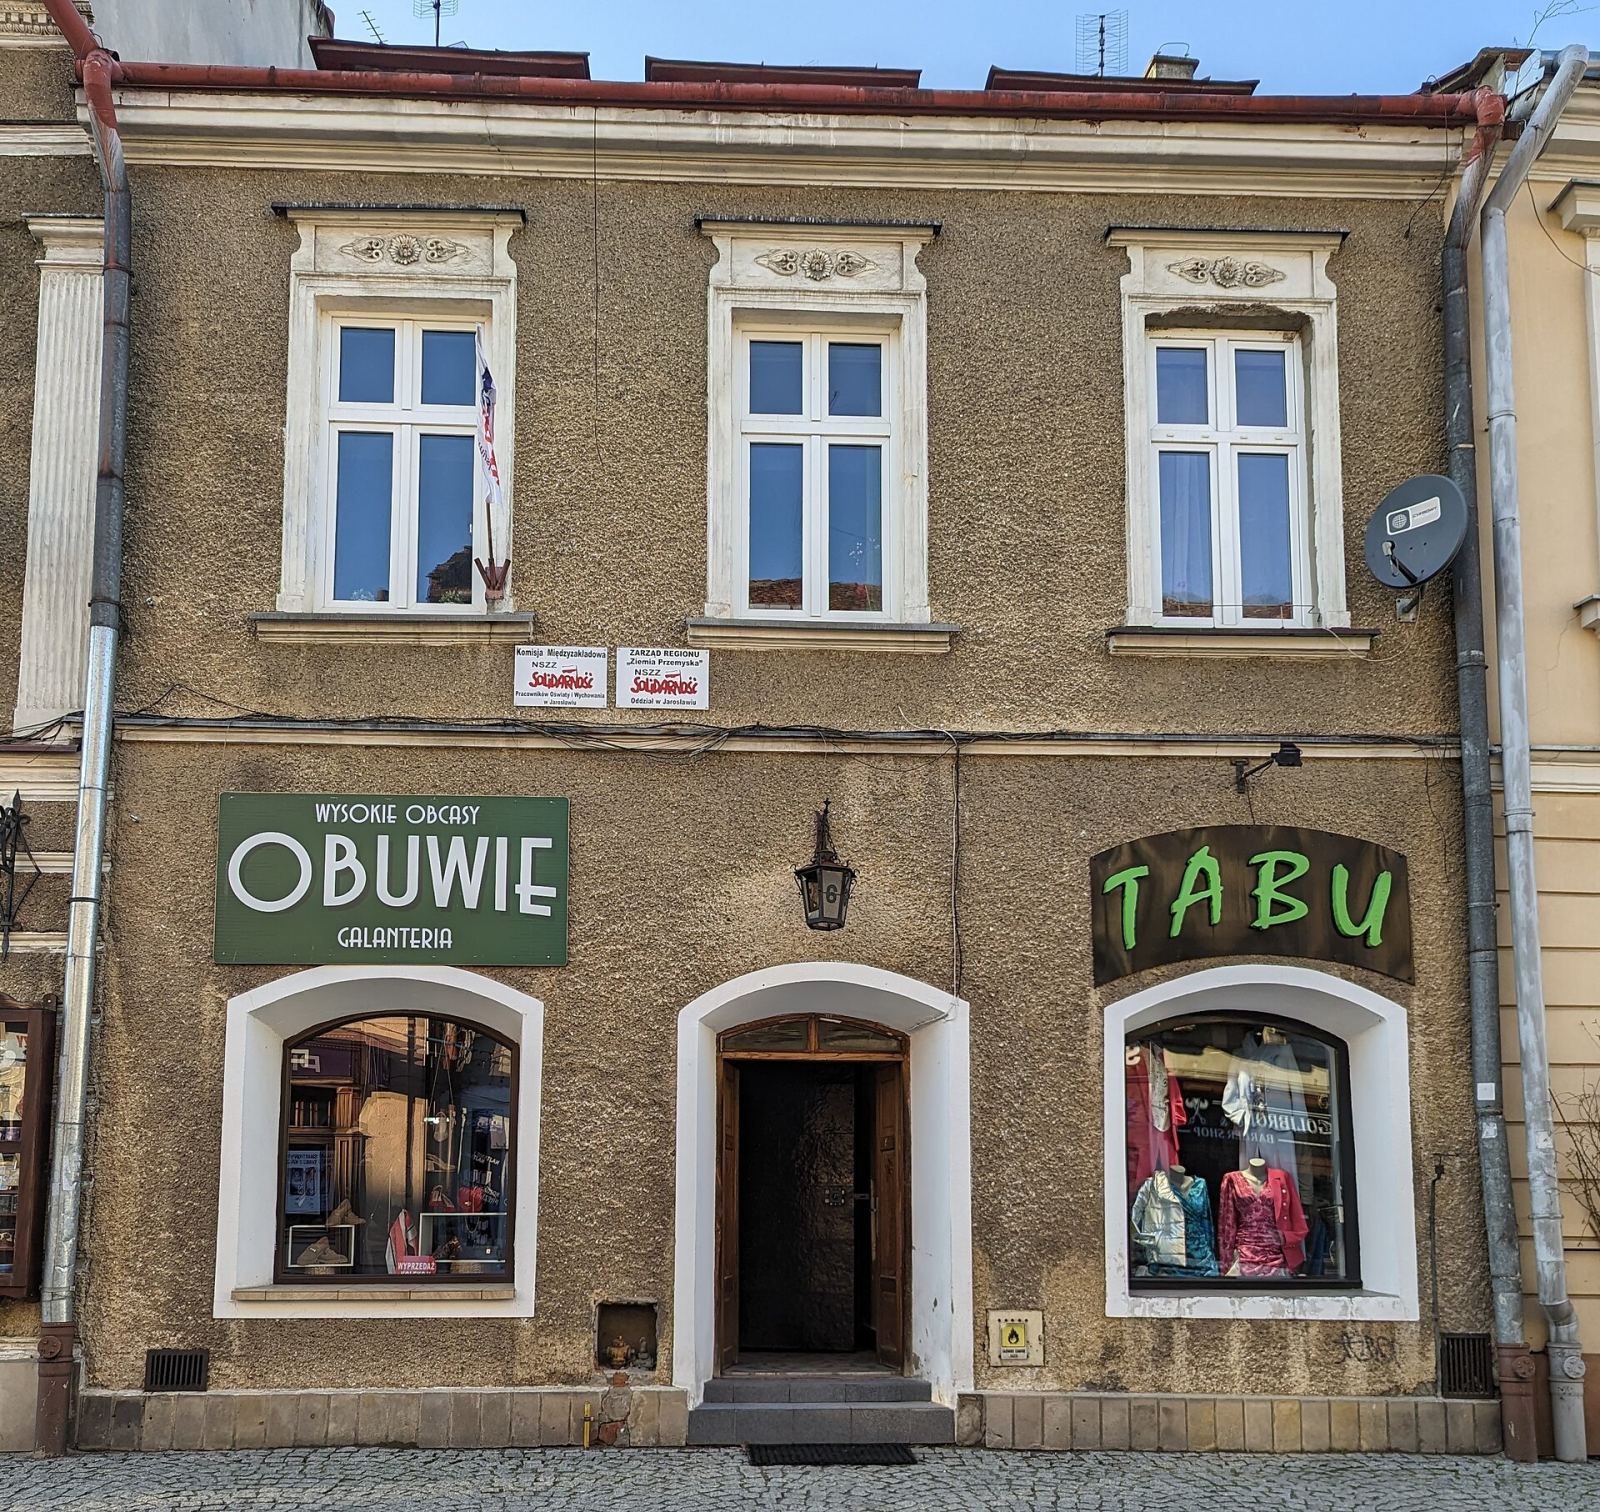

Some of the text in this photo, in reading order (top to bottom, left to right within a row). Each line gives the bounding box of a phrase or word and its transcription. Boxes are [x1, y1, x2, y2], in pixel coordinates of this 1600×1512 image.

[516, 648, 606, 659] Komisja Międzyzakładowa
[629, 649, 700, 658] ZARZĄD REGIONU
[531, 661, 557, 669] NSZZ
[634, 668, 661, 676] NSZZ
[515, 690, 549, 698] Pracowników
[630, 697, 654, 706] Oddział
[662, 698, 697, 706] Jarosławiu
[315, 803, 480, 825] WYSOKIE OBCASY
[227, 831, 557, 917] OBUWIE
[825, 884, 838, 904] 6
[1103, 845, 1392, 950] TABU
[337, 927, 453, 949] GALANTERIA
